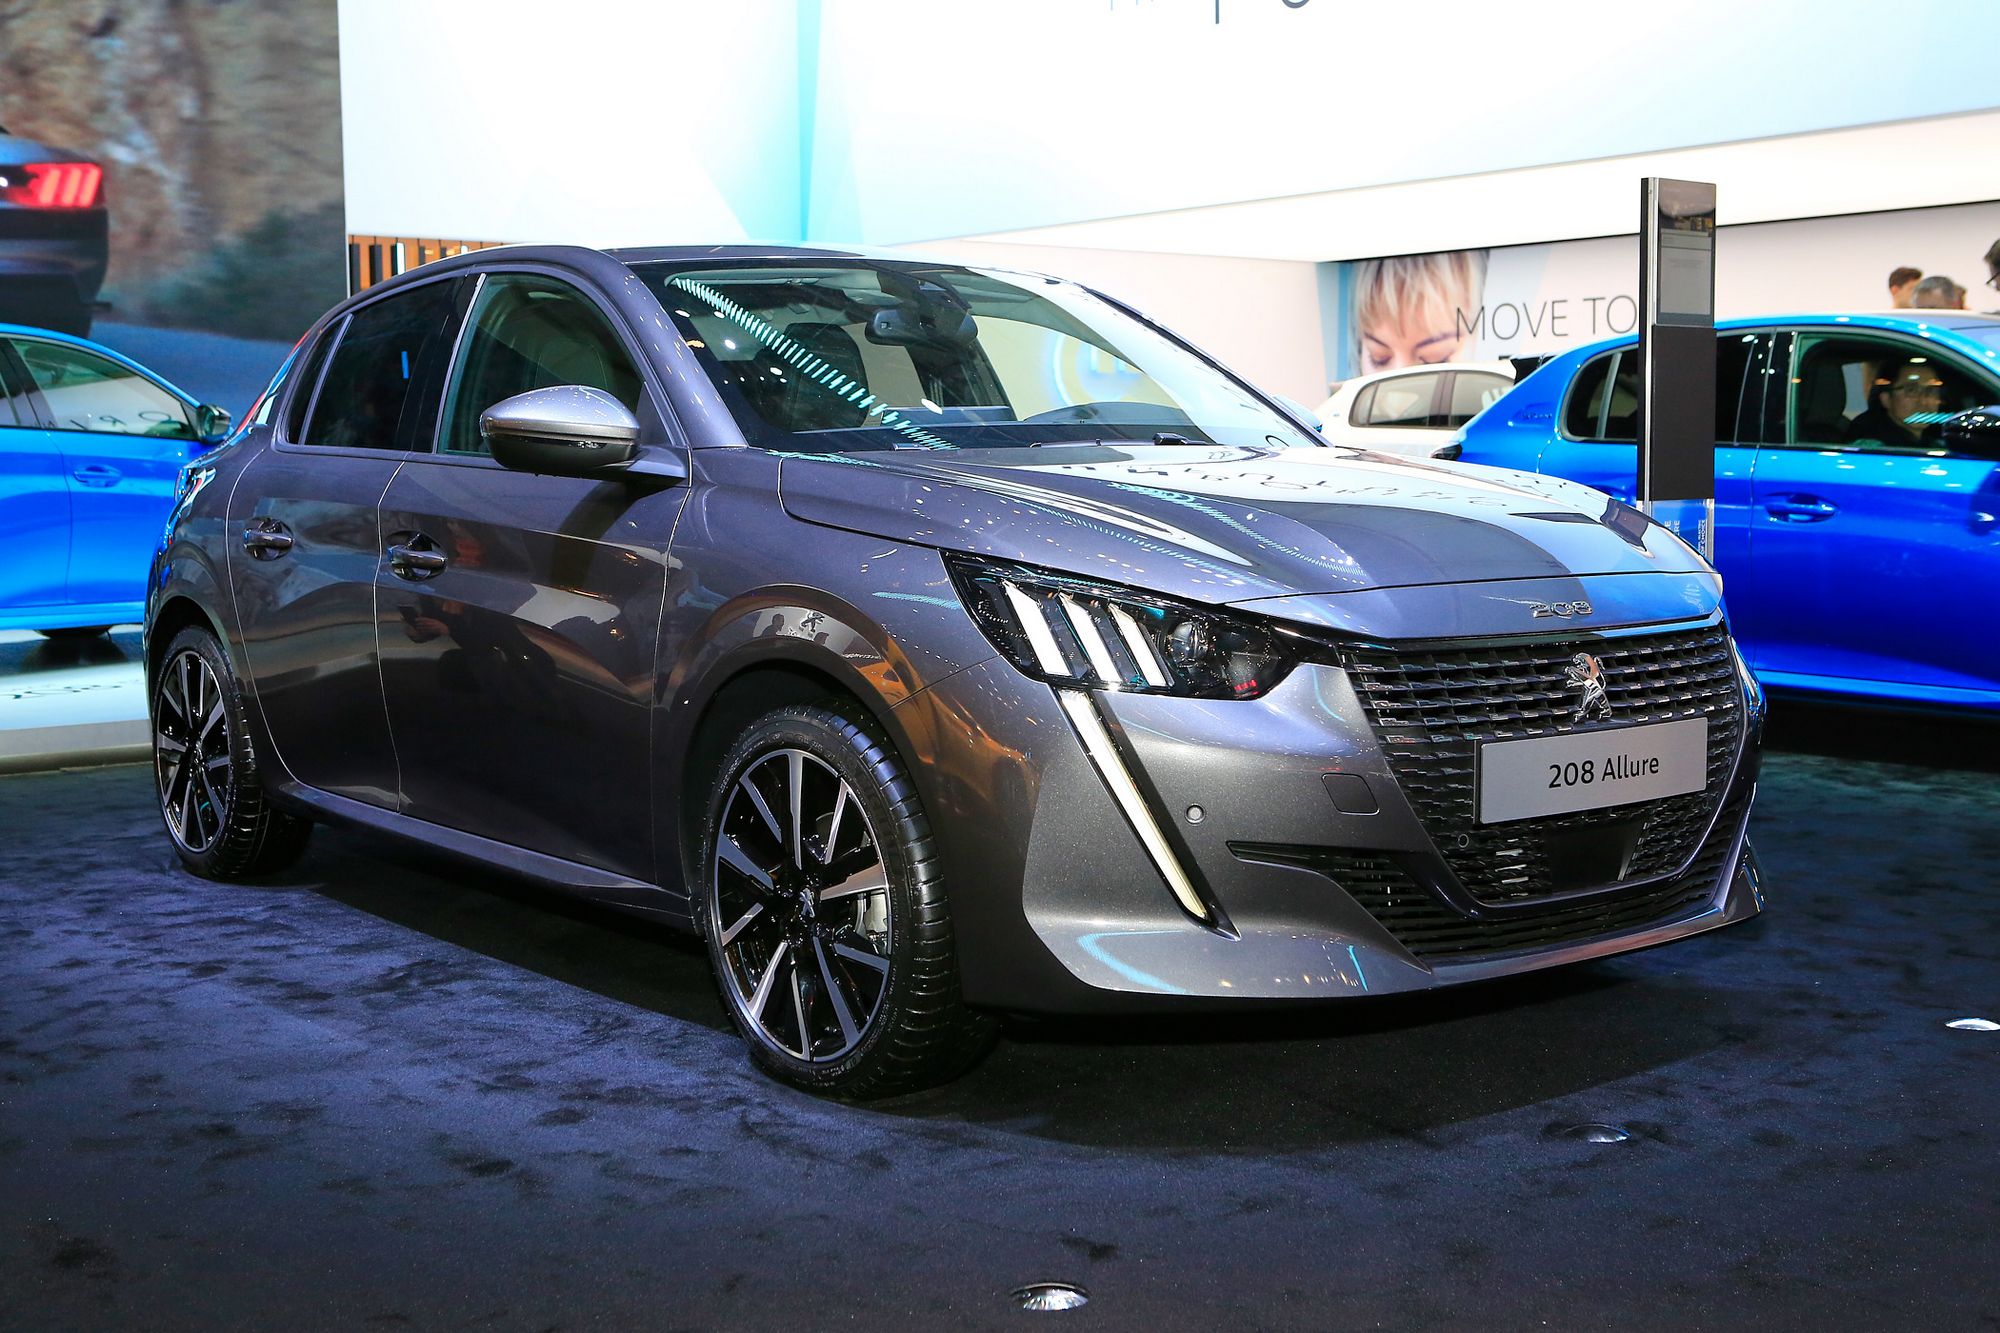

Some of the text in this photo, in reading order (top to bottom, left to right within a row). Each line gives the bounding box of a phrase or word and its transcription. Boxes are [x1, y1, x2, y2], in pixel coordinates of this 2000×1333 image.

[1456, 295, 1638, 342] MOVE TO
[1529, 600, 1593, 619] 208
[1548, 754, 1660, 789] 208 Allure
